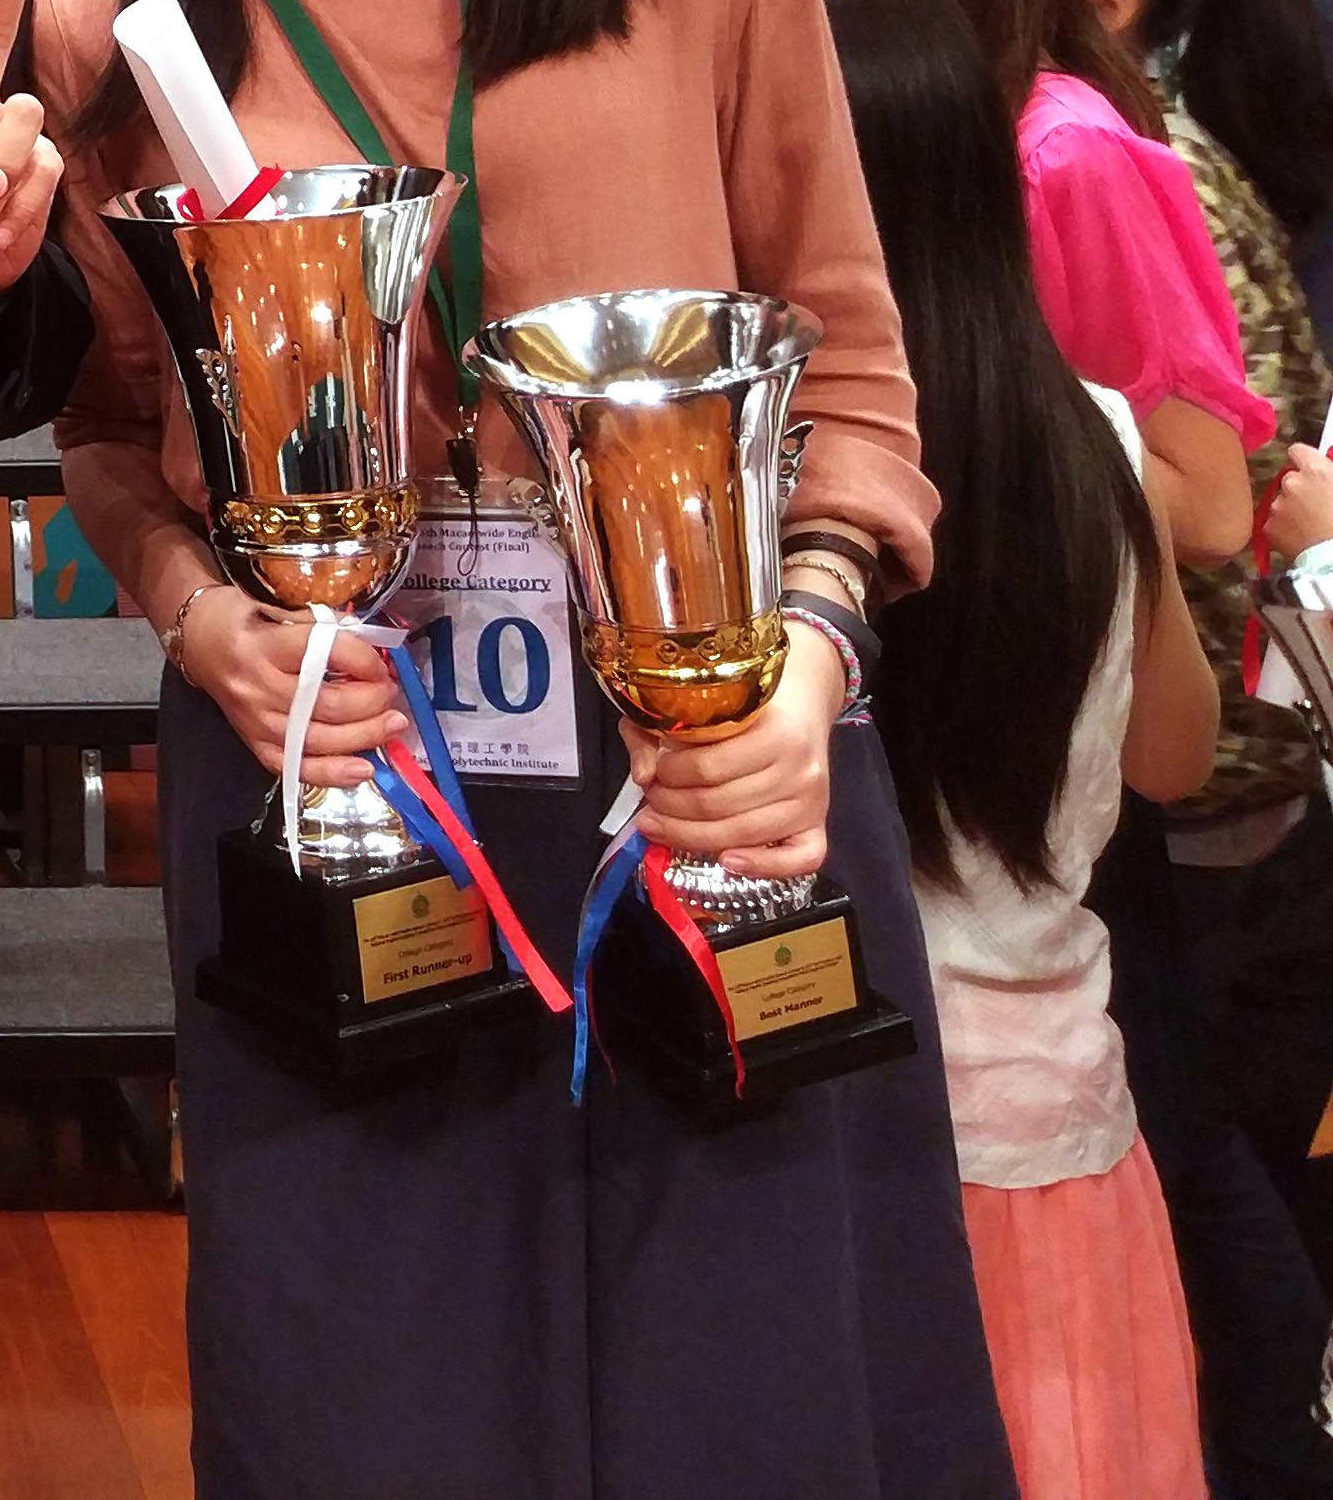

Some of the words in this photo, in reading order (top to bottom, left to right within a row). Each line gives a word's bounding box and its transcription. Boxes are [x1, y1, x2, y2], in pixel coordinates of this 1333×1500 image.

[403, 573, 461, 592] ollege
[465, 574, 552, 593] Category
[408, 614, 551, 715] 10
[452, 756, 510, 768] olytechnic
[383, 968, 410, 985] First
[411, 953, 473, 977] Runner-up
